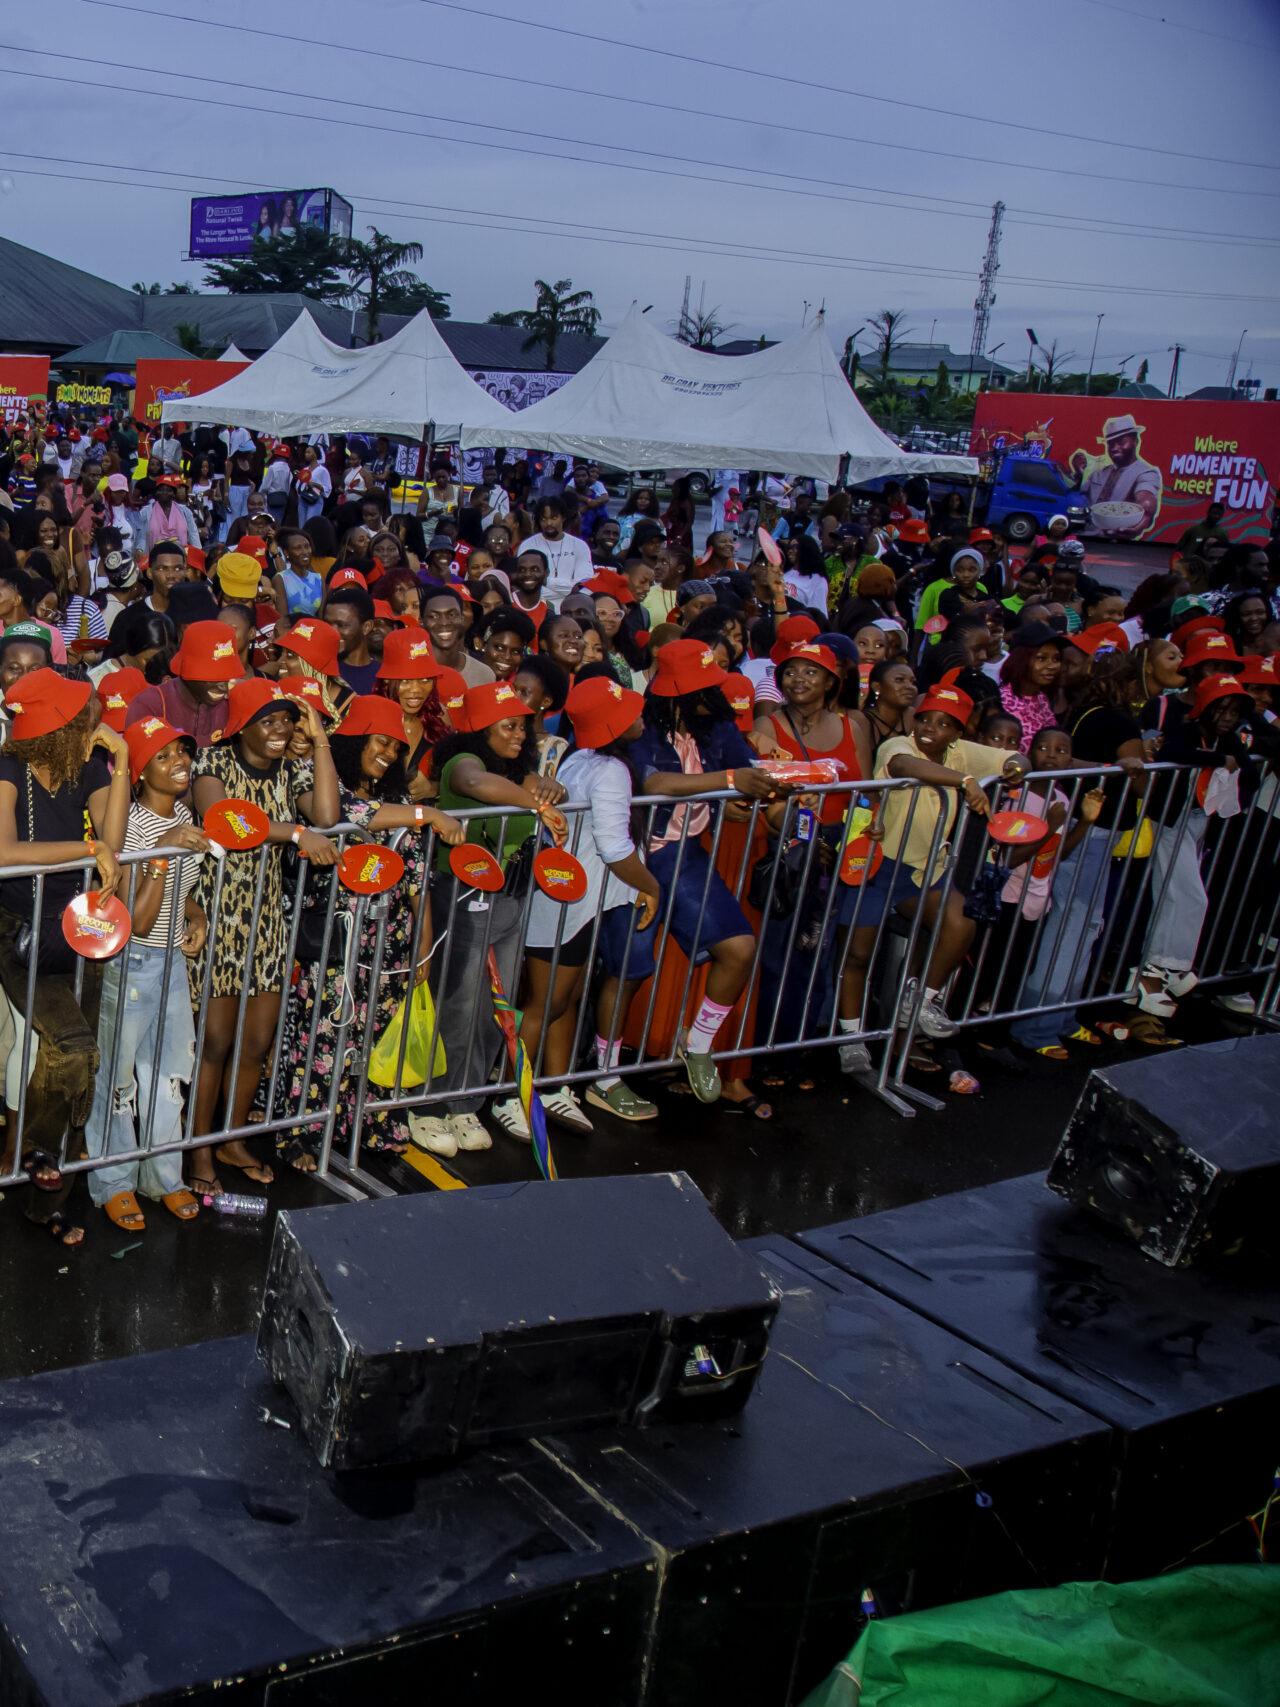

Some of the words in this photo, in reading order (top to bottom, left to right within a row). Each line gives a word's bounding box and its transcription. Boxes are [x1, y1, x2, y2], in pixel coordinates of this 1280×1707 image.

[1195, 435, 1238, 453] Where
[1170, 454, 1257, 479] MOMENTS
[1174, 477, 1214, 495] meet
[1214, 477, 1269, 510] FUN
[225, 811, 248, 838] PALOOZA
[360, 854, 380, 882] PALOOZA
[544, 869, 574, 880] PALOOZA
[77, 913, 116, 934] PALOOZA
